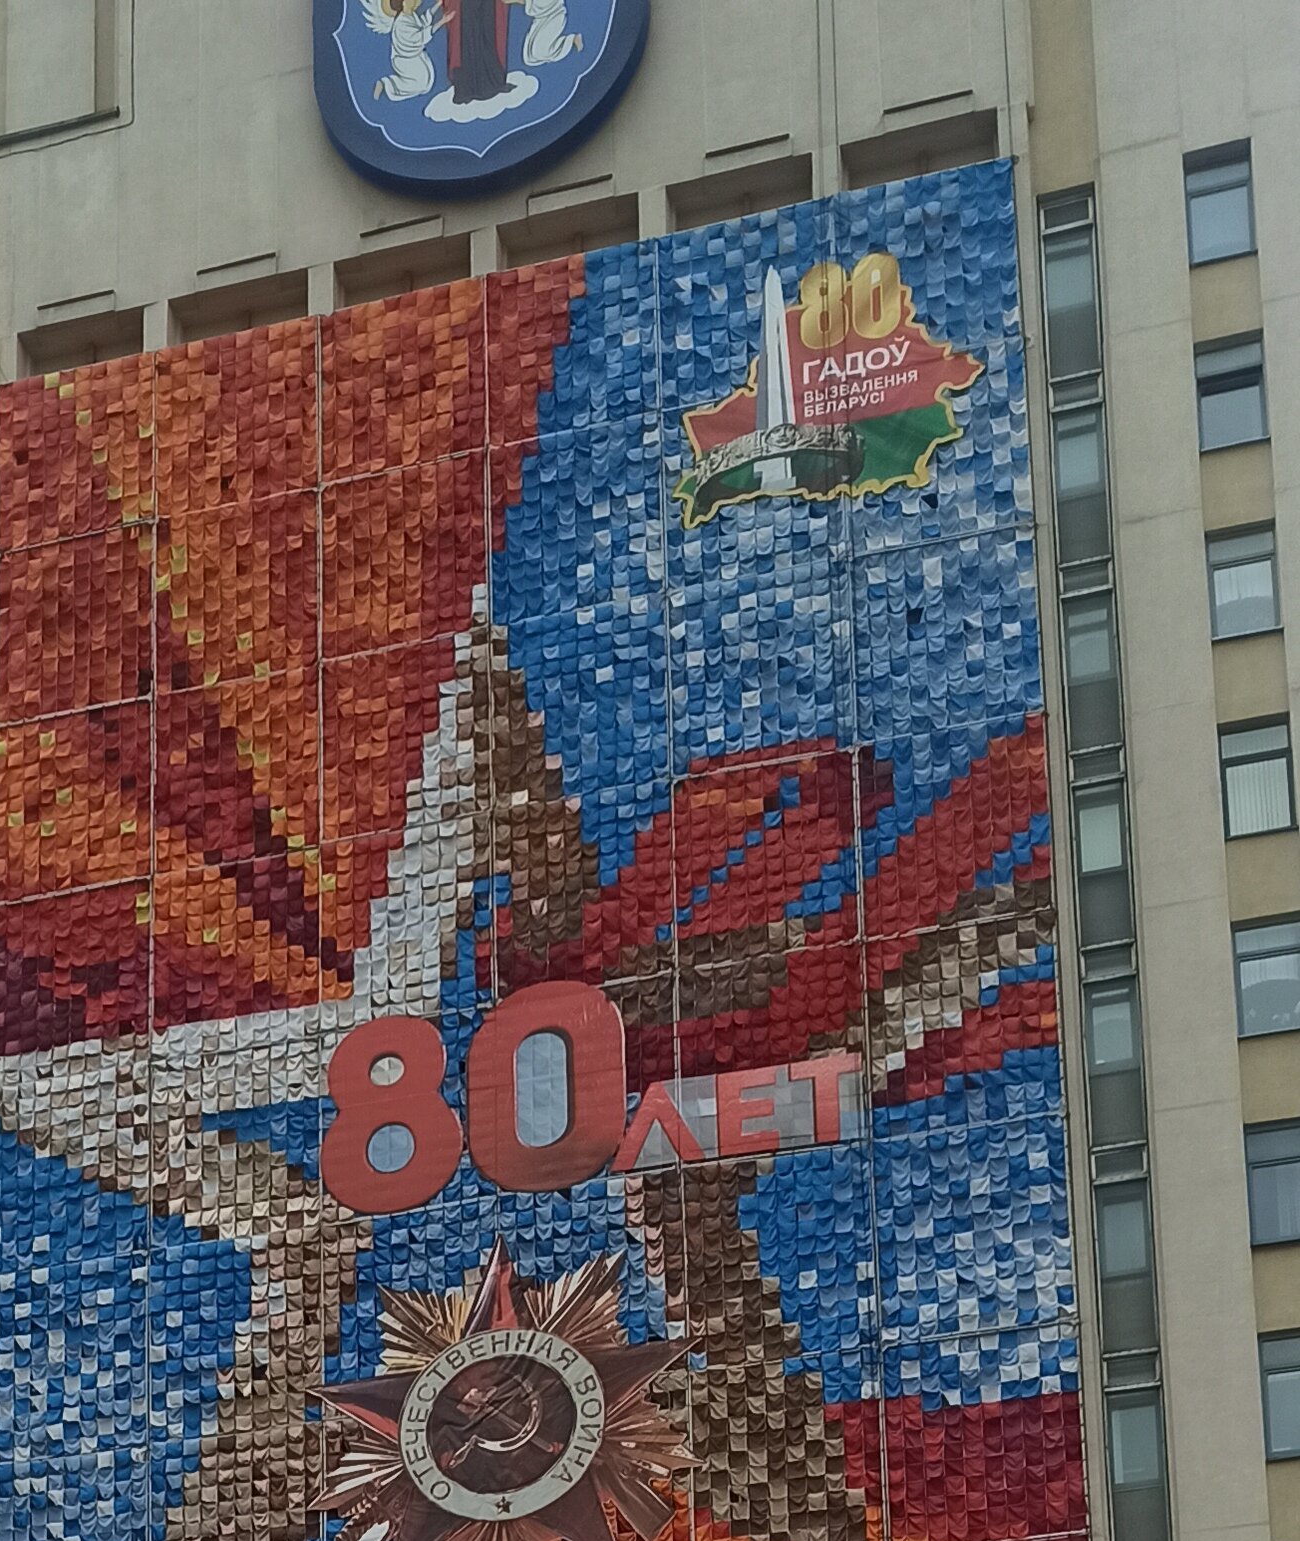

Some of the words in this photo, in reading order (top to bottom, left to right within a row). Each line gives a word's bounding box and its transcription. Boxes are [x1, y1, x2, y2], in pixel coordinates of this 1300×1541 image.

[800, 252, 901, 349] 80
[802, 335, 911, 385] ГАДОЎ
[803, 369, 919, 404] ВЫЗВАЛЕННЯ
[804, 391, 885, 418] БЕЛАРУСІ
[320, 980, 626, 1213] 80
[610, 1047, 867, 1174] ЛЕТ
[407, 1330, 579, 1501] ОТЕЧЕСТВЕННАЯ
[559, 1374, 601, 1485] ВОЙНА
